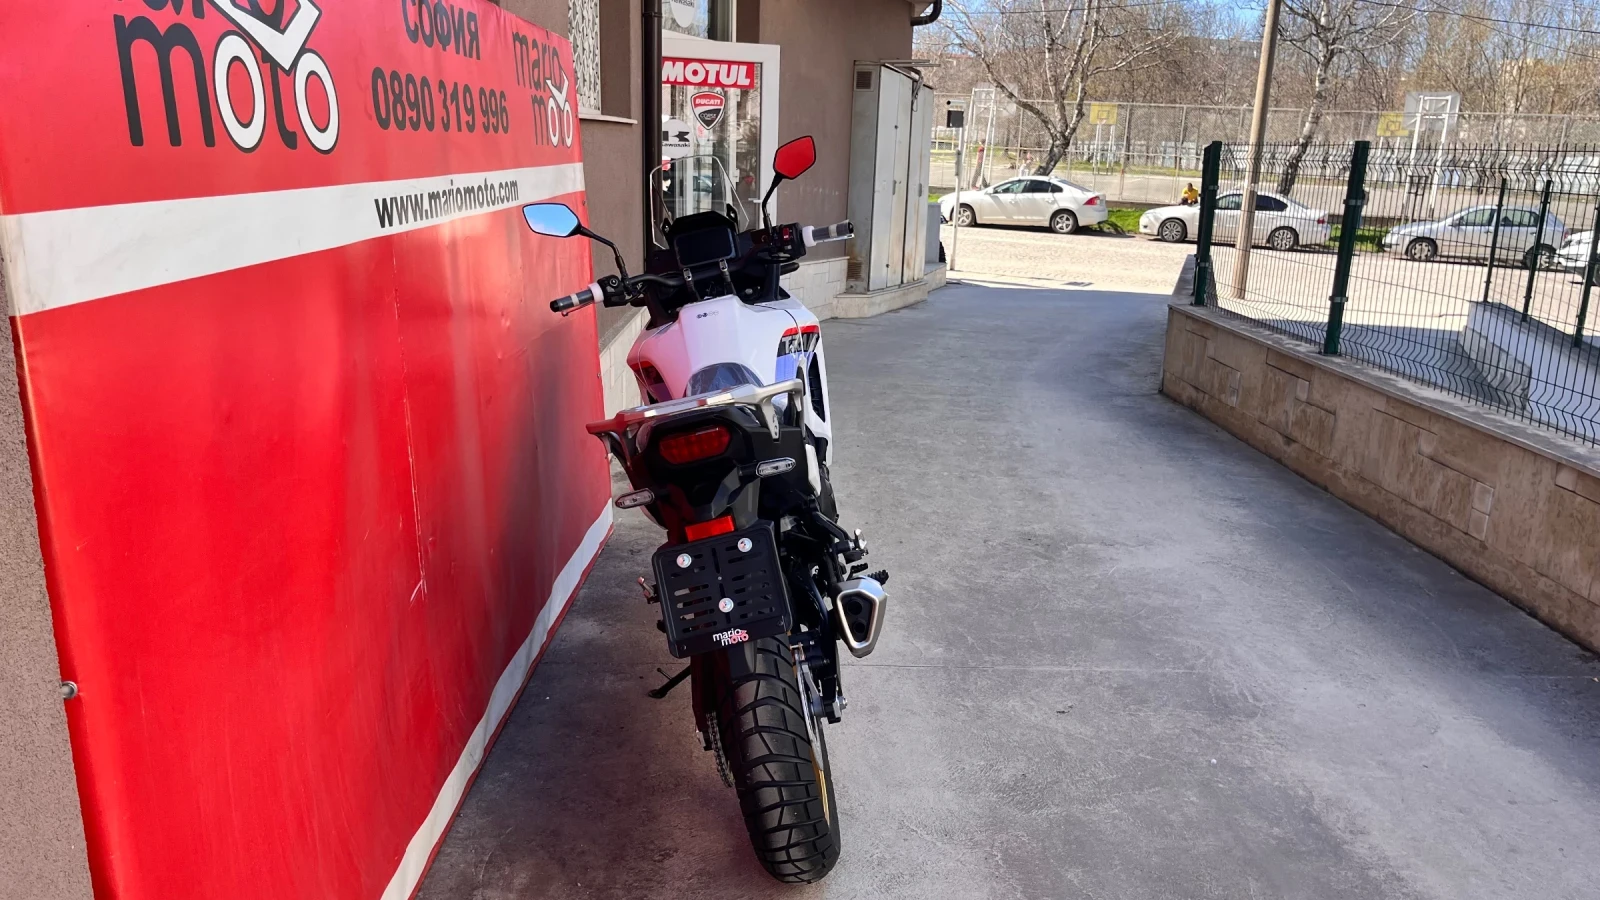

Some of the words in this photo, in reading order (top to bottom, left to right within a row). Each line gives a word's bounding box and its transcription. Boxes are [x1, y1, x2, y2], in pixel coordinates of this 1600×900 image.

[401, 0, 481, 61] СОФИЯ
[113, 13, 340, 155] moto
[511, 30, 565, 93] mario
[662, 61, 751, 86] MOTUL
[371, 66, 435, 133] 0890
[437, 79, 476, 135] 319
[478, 86, 510, 135] 996
[530, 94, 574, 149] moto
[695, 98, 721, 106] DUCATI
[374, 178, 520, 229] www.mariomoto.com
[712, 627, 742, 642] mario
[721, 632, 749, 646] moto
